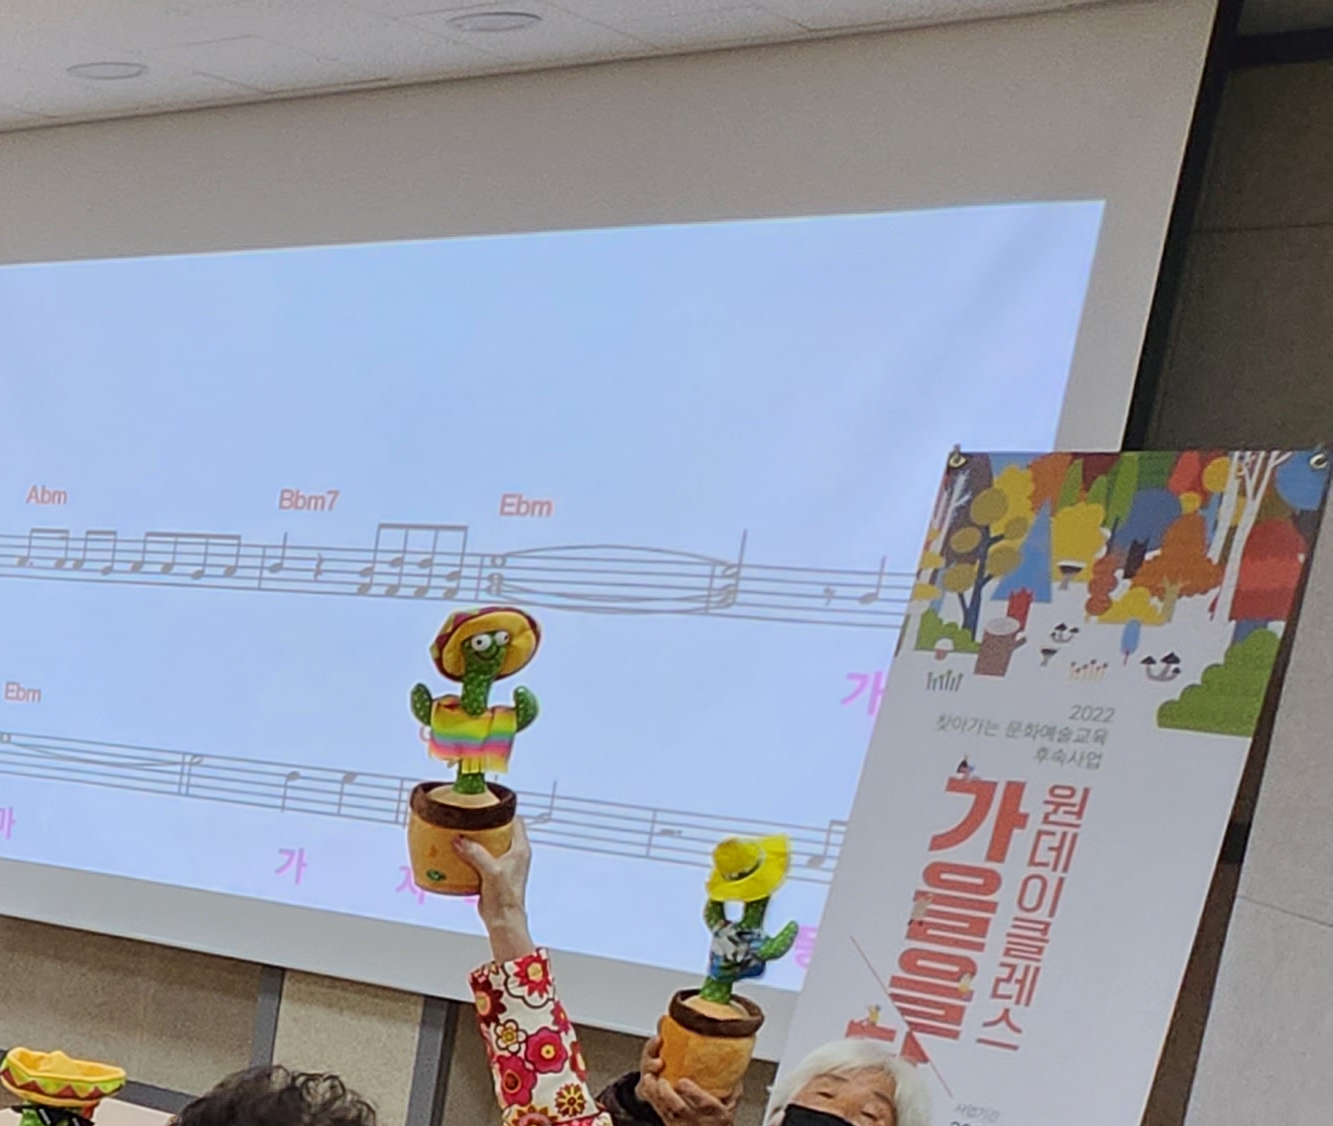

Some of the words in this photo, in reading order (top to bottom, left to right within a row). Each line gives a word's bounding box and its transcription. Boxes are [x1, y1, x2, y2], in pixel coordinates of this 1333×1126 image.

[26, 485, 68, 505] Abm
[278, 489, 340, 512] Bbm7
[499, 493, 553, 517] Ebm
[4, 681, 42, 703] Ebm
[1069, 704, 1116, 723] 2022
[936, 714, 1000, 738] 찾아가는
[1005, 720, 1110, 746] 문화예술교육
[1036, 747, 1103, 770] 후속사업
[275, 848, 308, 885] 가
